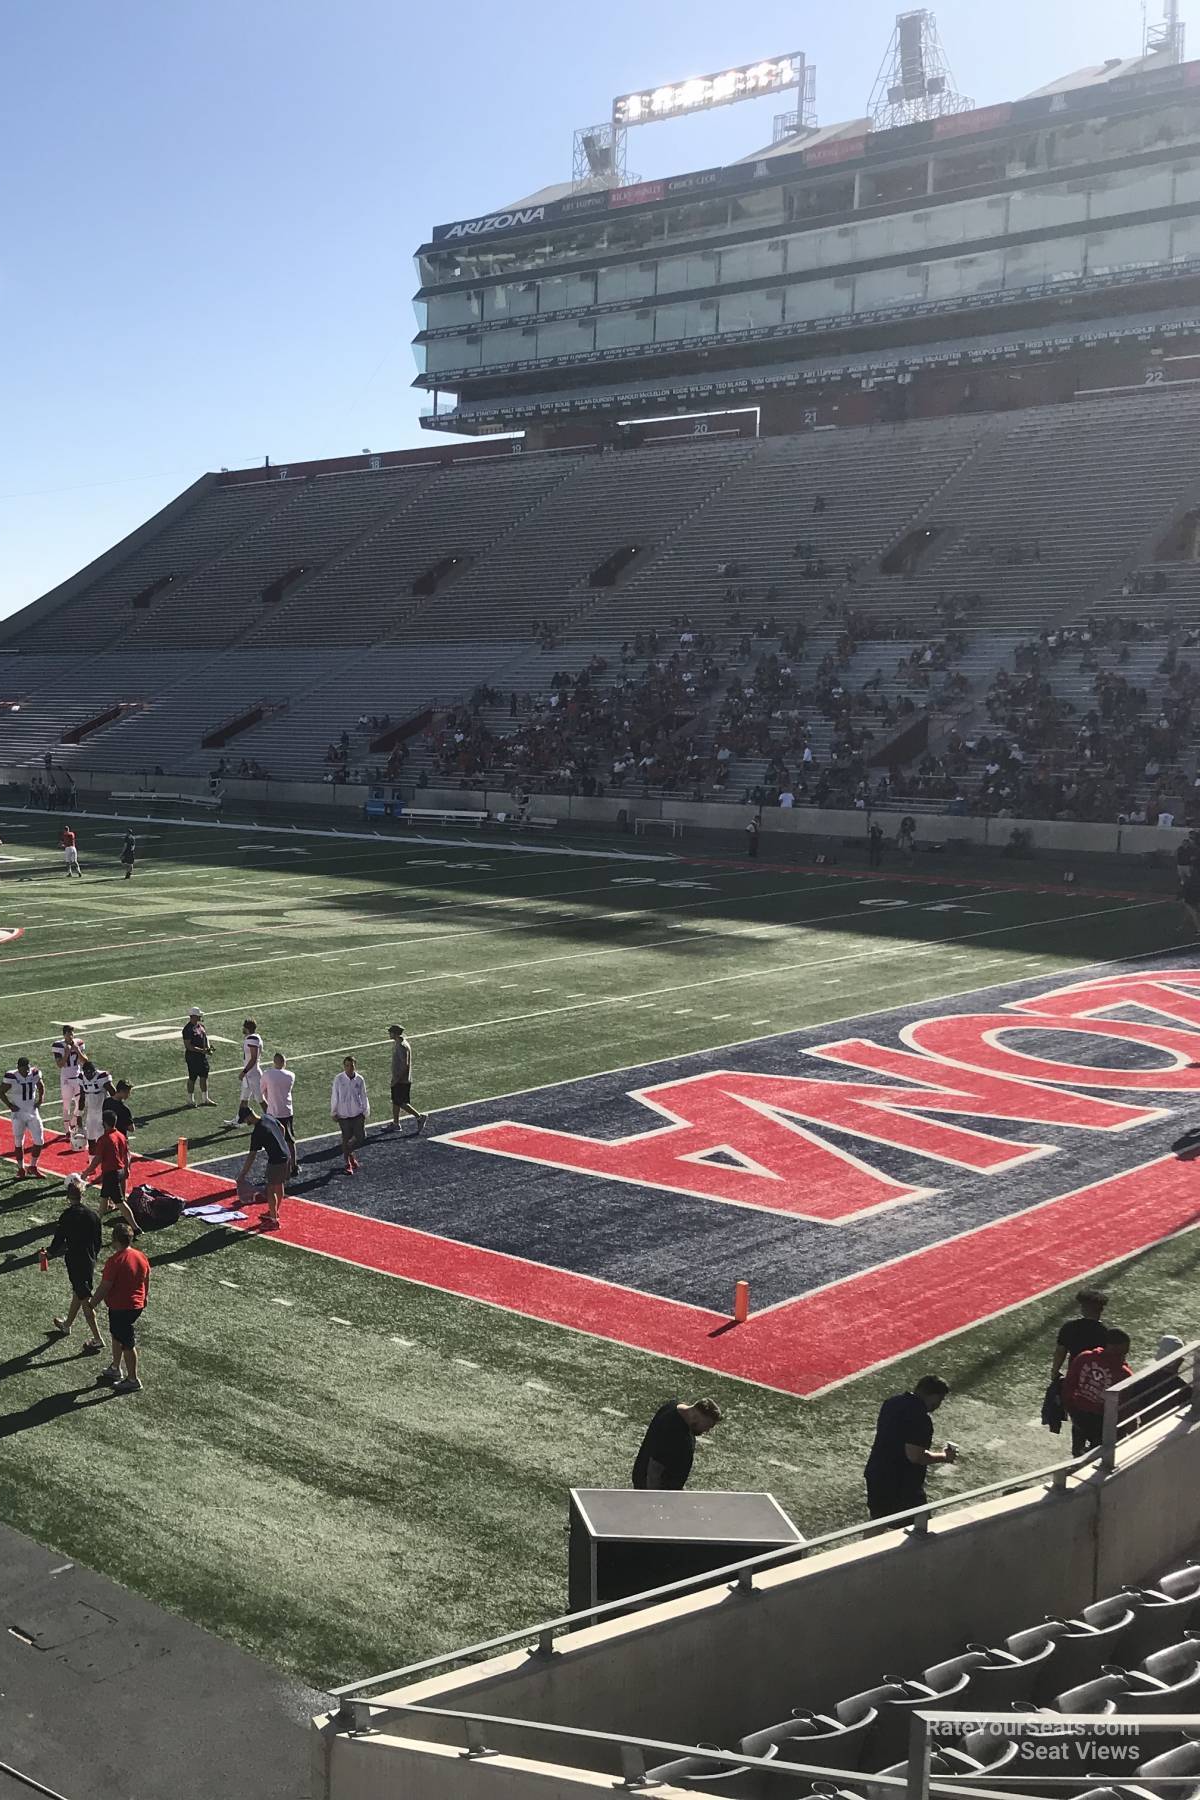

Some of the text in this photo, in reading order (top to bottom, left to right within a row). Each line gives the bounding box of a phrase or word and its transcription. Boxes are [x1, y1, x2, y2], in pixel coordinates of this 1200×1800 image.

[444, 207, 545, 240] ARIZONA
[1144, 371, 1164, 385] 22
[689, 383, 712, 393] WILSON
[804, 412, 817, 423] 21
[694, 424, 708, 434] 20
[511, 444, 522, 453] 19
[21, 1082, 33, 1101] 11
